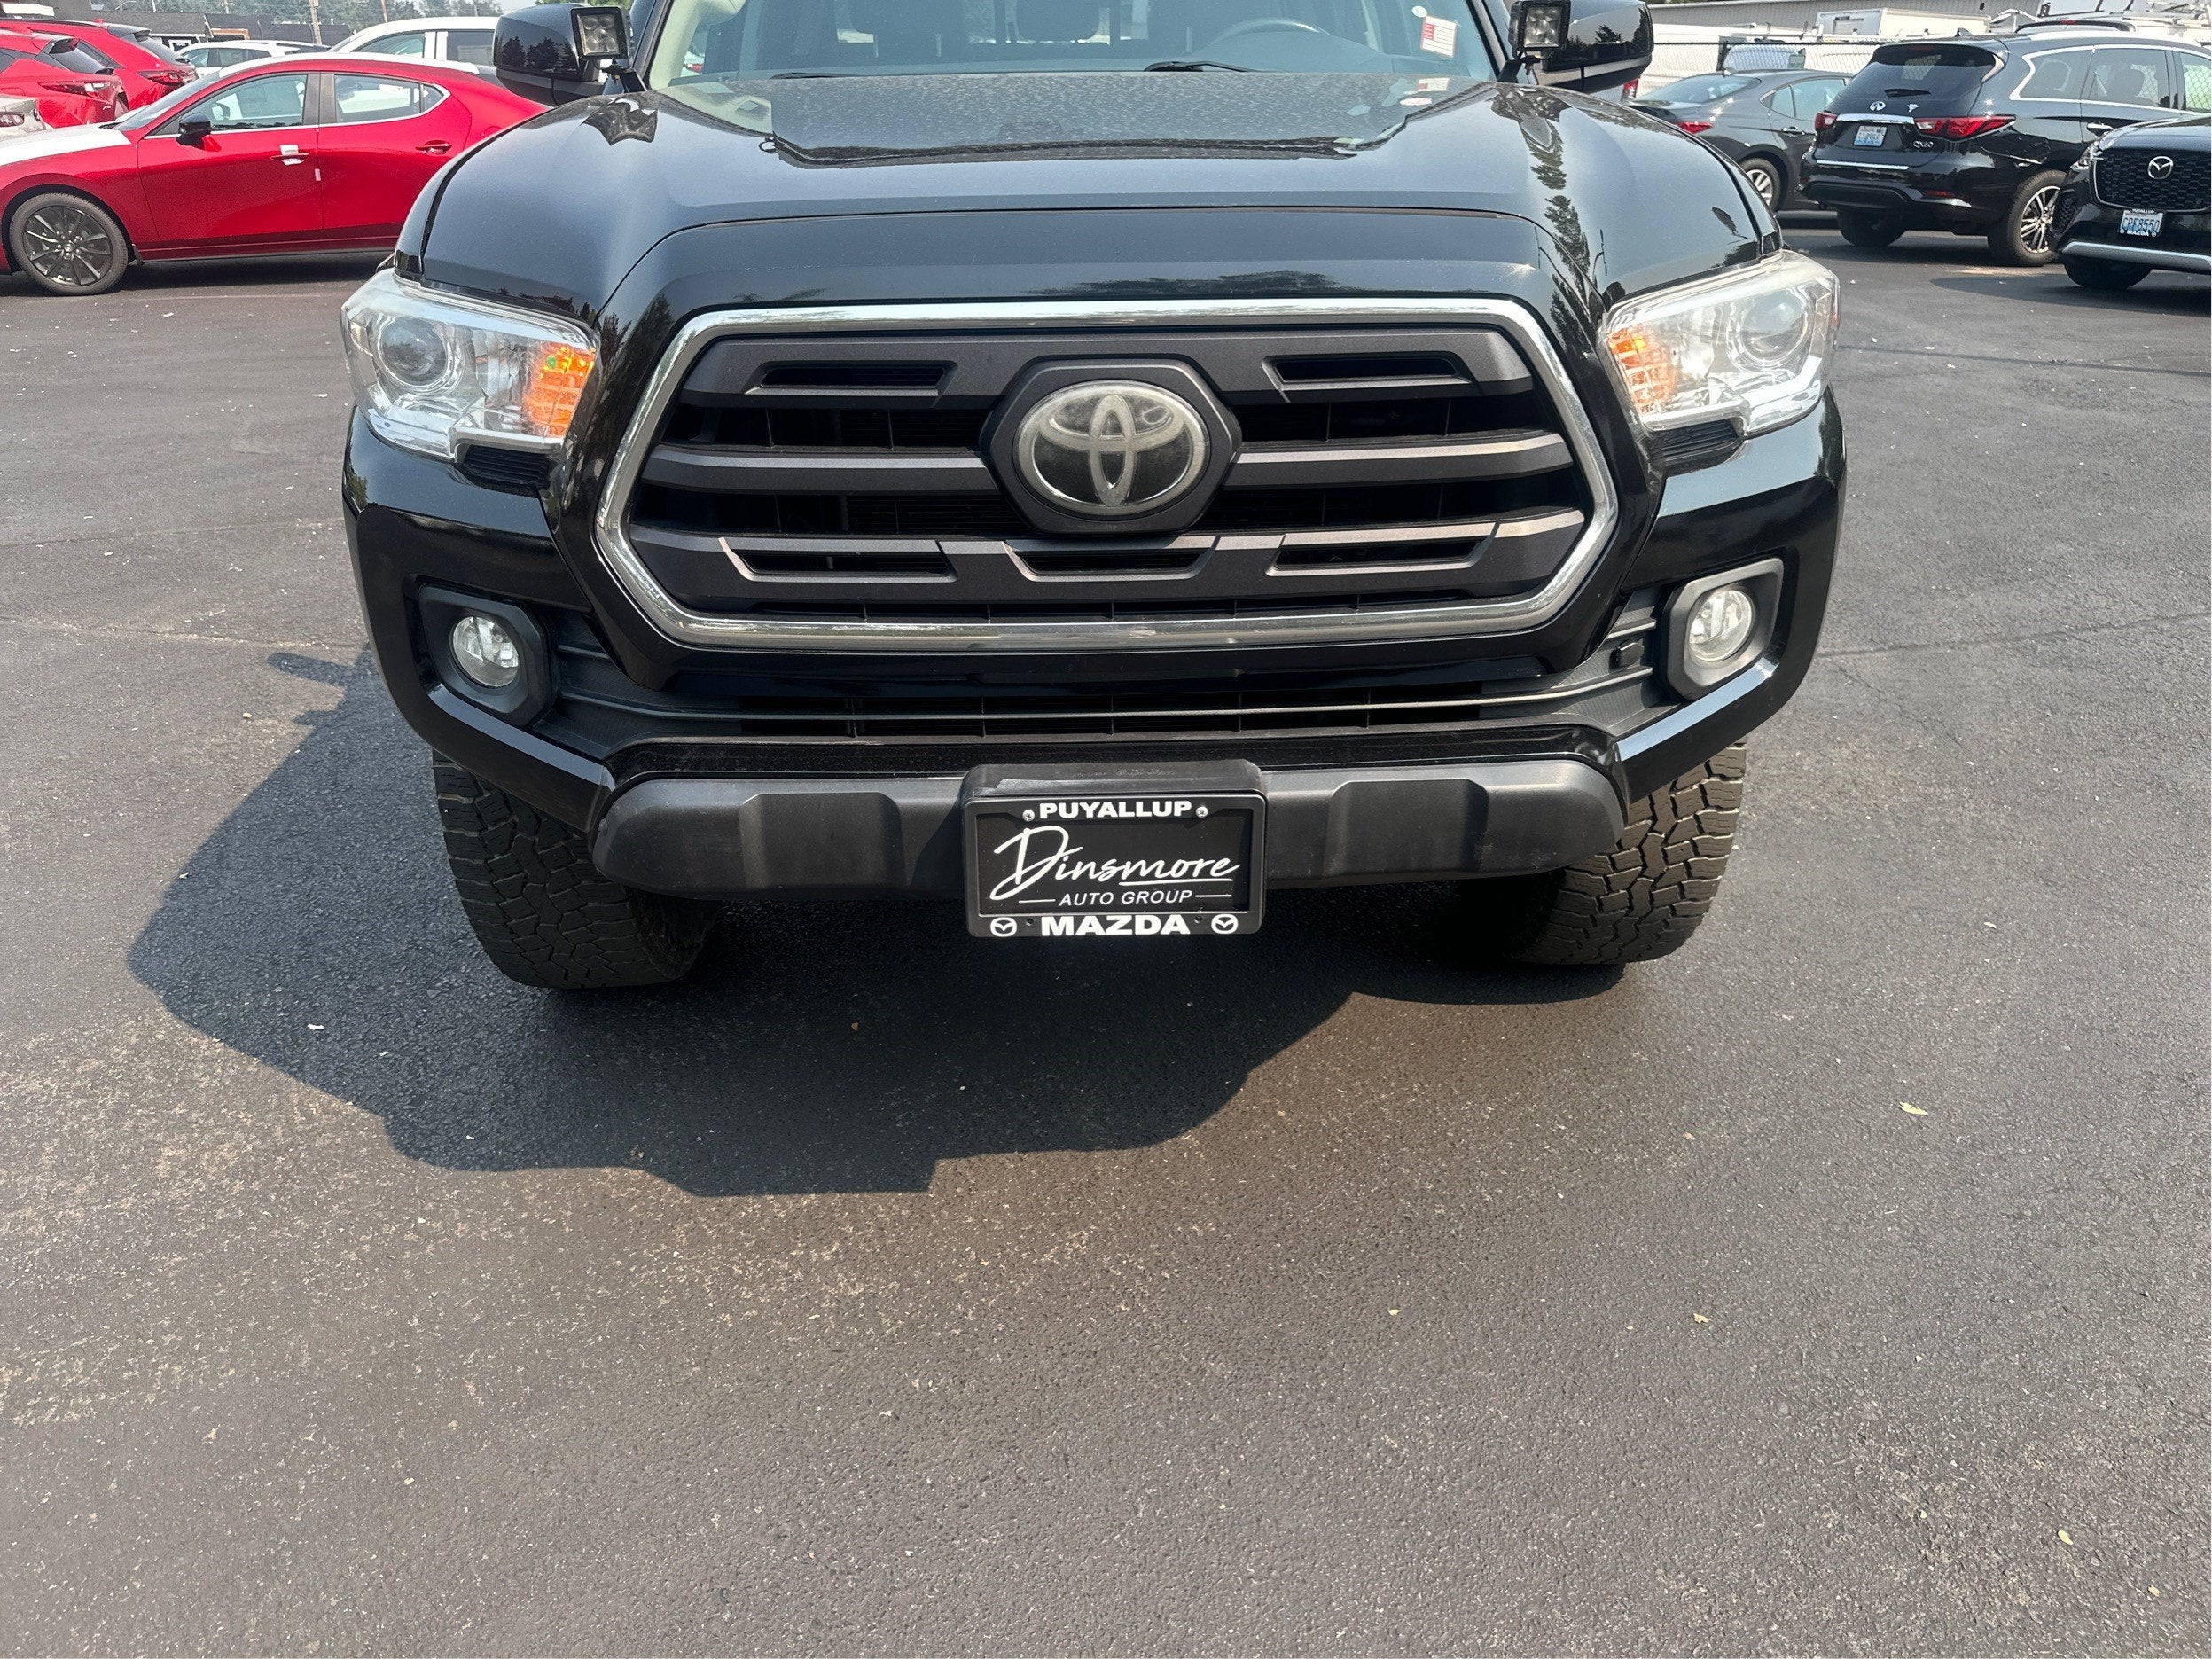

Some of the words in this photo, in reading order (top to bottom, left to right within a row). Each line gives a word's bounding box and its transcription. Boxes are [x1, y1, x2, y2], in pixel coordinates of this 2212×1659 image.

[1039, 800, 1192, 819] PUYALLUP
[989, 825, 1241, 901] Dinsmore
[1058, 892, 1114, 907] AUTO
[1121, 889, 1193, 904] GROUP
[1041, 914, 1191, 936] MAZDA
